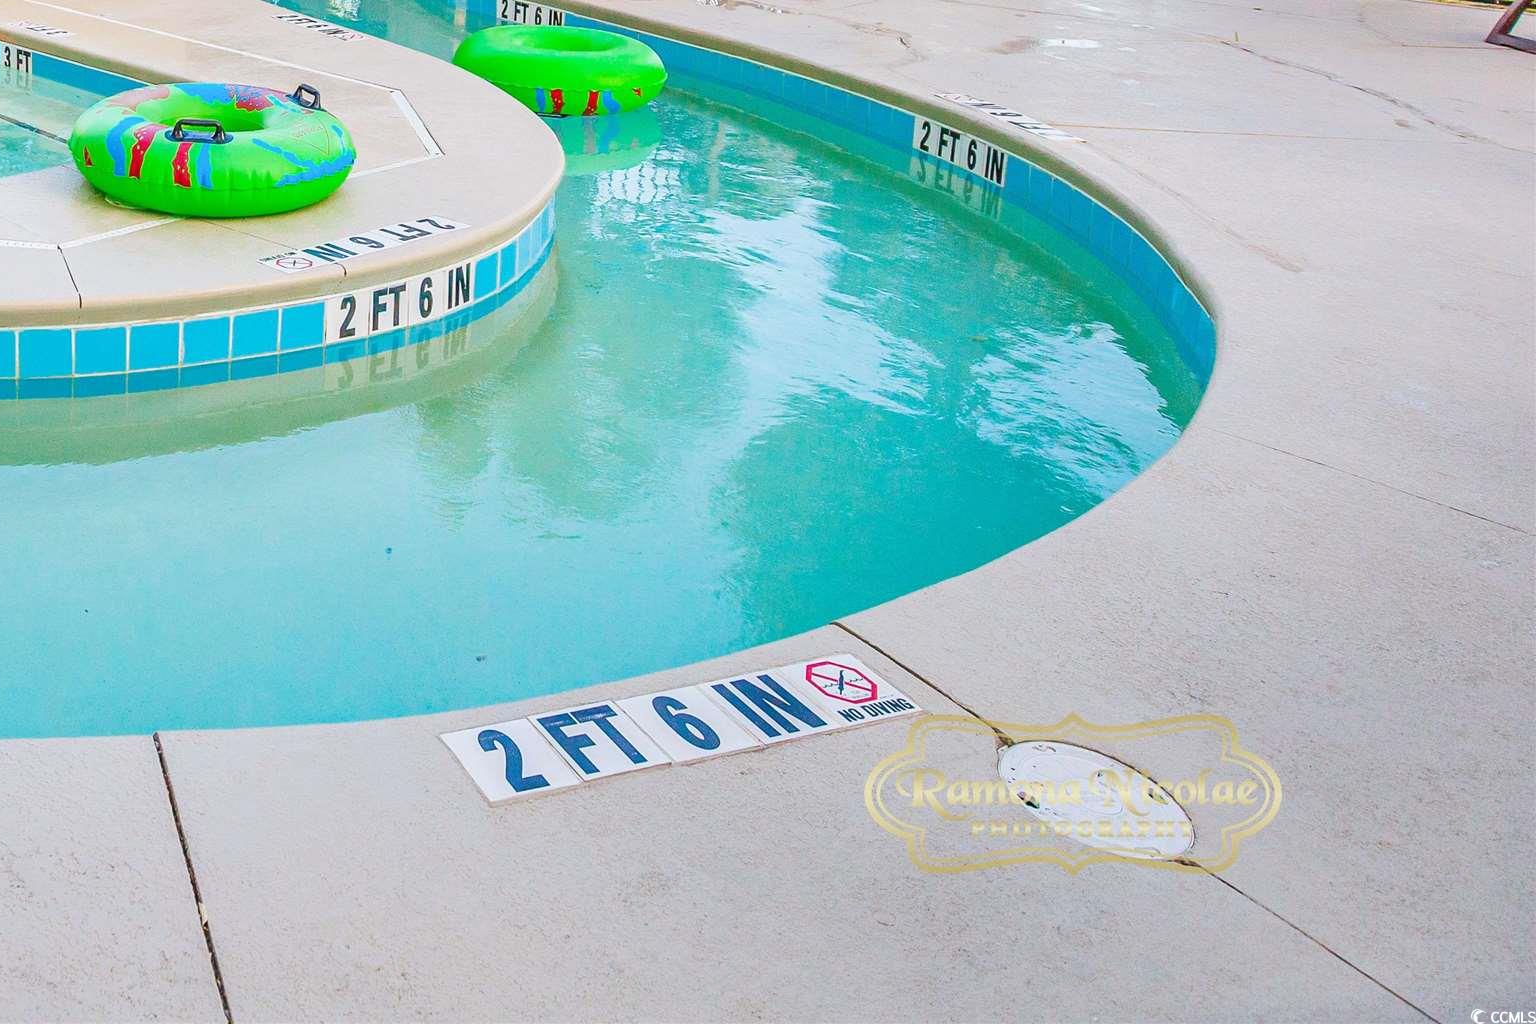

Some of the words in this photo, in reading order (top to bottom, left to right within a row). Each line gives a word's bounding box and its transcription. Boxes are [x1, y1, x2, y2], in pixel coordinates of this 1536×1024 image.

[514, 1, 529, 24] FT
[534, 6, 542, 26] 6
[548, 9, 563, 26] IN
[4, 46, 11, 67] 3
[16, 48, 32, 73] FT
[920, 121, 931, 152] 2
[938, 127, 961, 163] FT
[967, 139, 977, 170] 6
[985, 146, 1004, 185] IN
[379, 223, 432, 242] FT
[418, 218, 456, 230] 2
[301, 243, 359, 263] IN
[349, 236, 385, 249] 6
[339, 295, 356, 339] 2
[372, 282, 407, 331] FT
[419, 276, 433, 319] 6
[447, 262, 471, 310] IN
[837, 708, 862, 723] NO
[860, 698, 915, 718] DIVING
[477, 729, 550, 792] 2
[537, 704, 649, 774] FT
[651, 695, 721, 750] 6
[710, 674, 828, 738] IN
